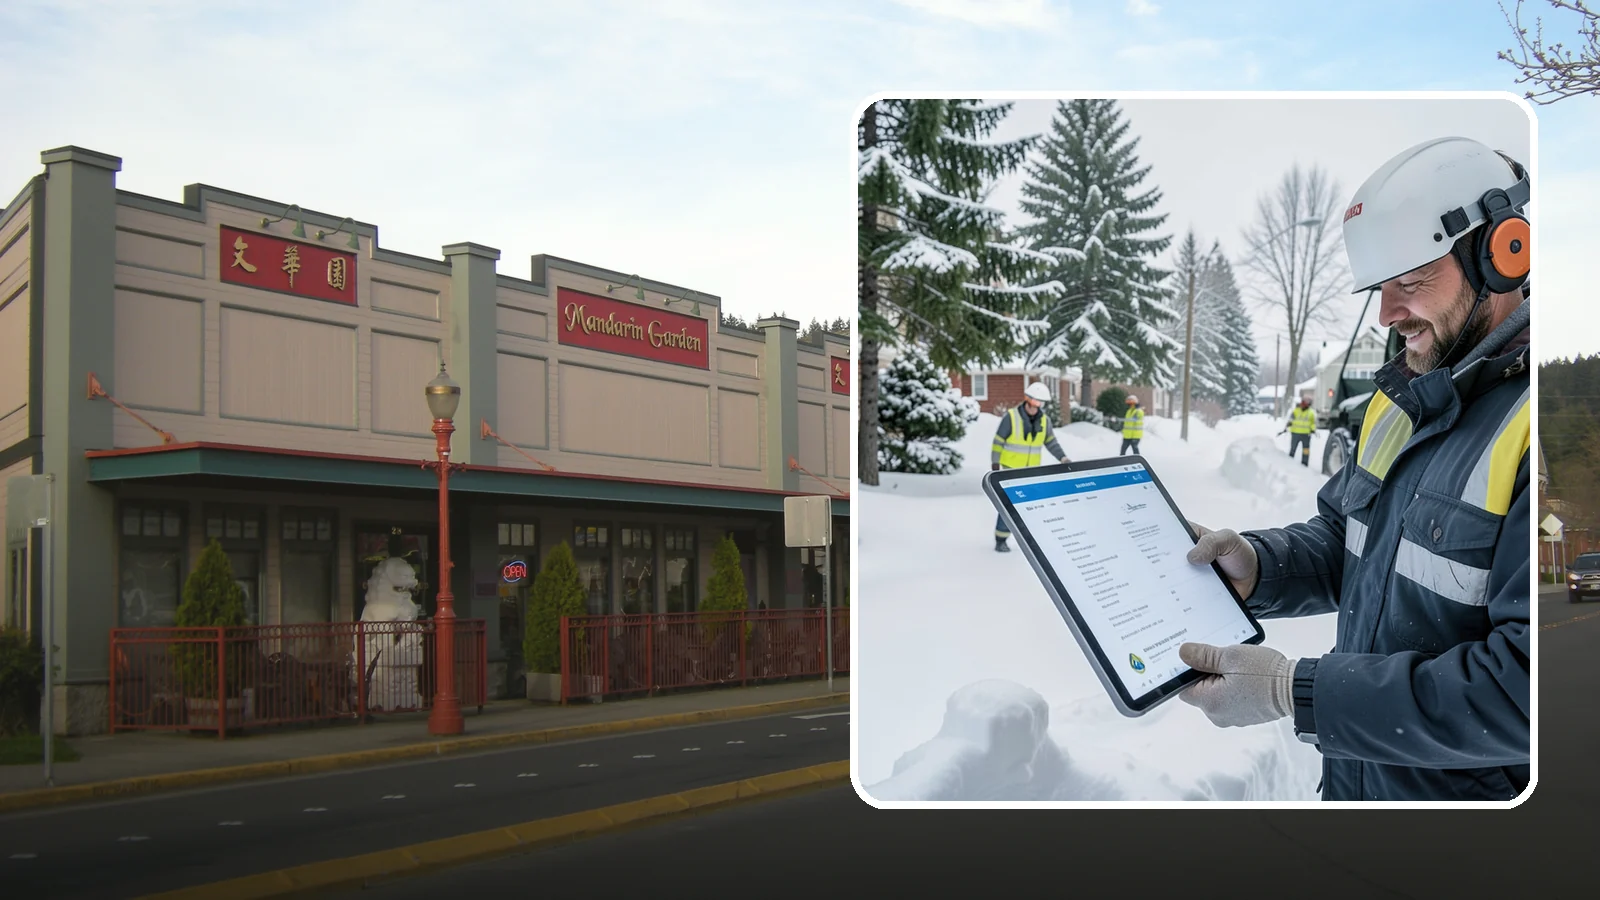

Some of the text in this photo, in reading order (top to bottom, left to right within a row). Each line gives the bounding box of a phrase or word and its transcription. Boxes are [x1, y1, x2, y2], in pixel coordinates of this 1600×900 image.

[230, 235, 346, 291] 文華園
[564, 302, 702, 352] Mandarin Garden
[504, 565, 527, 578] OPEN
